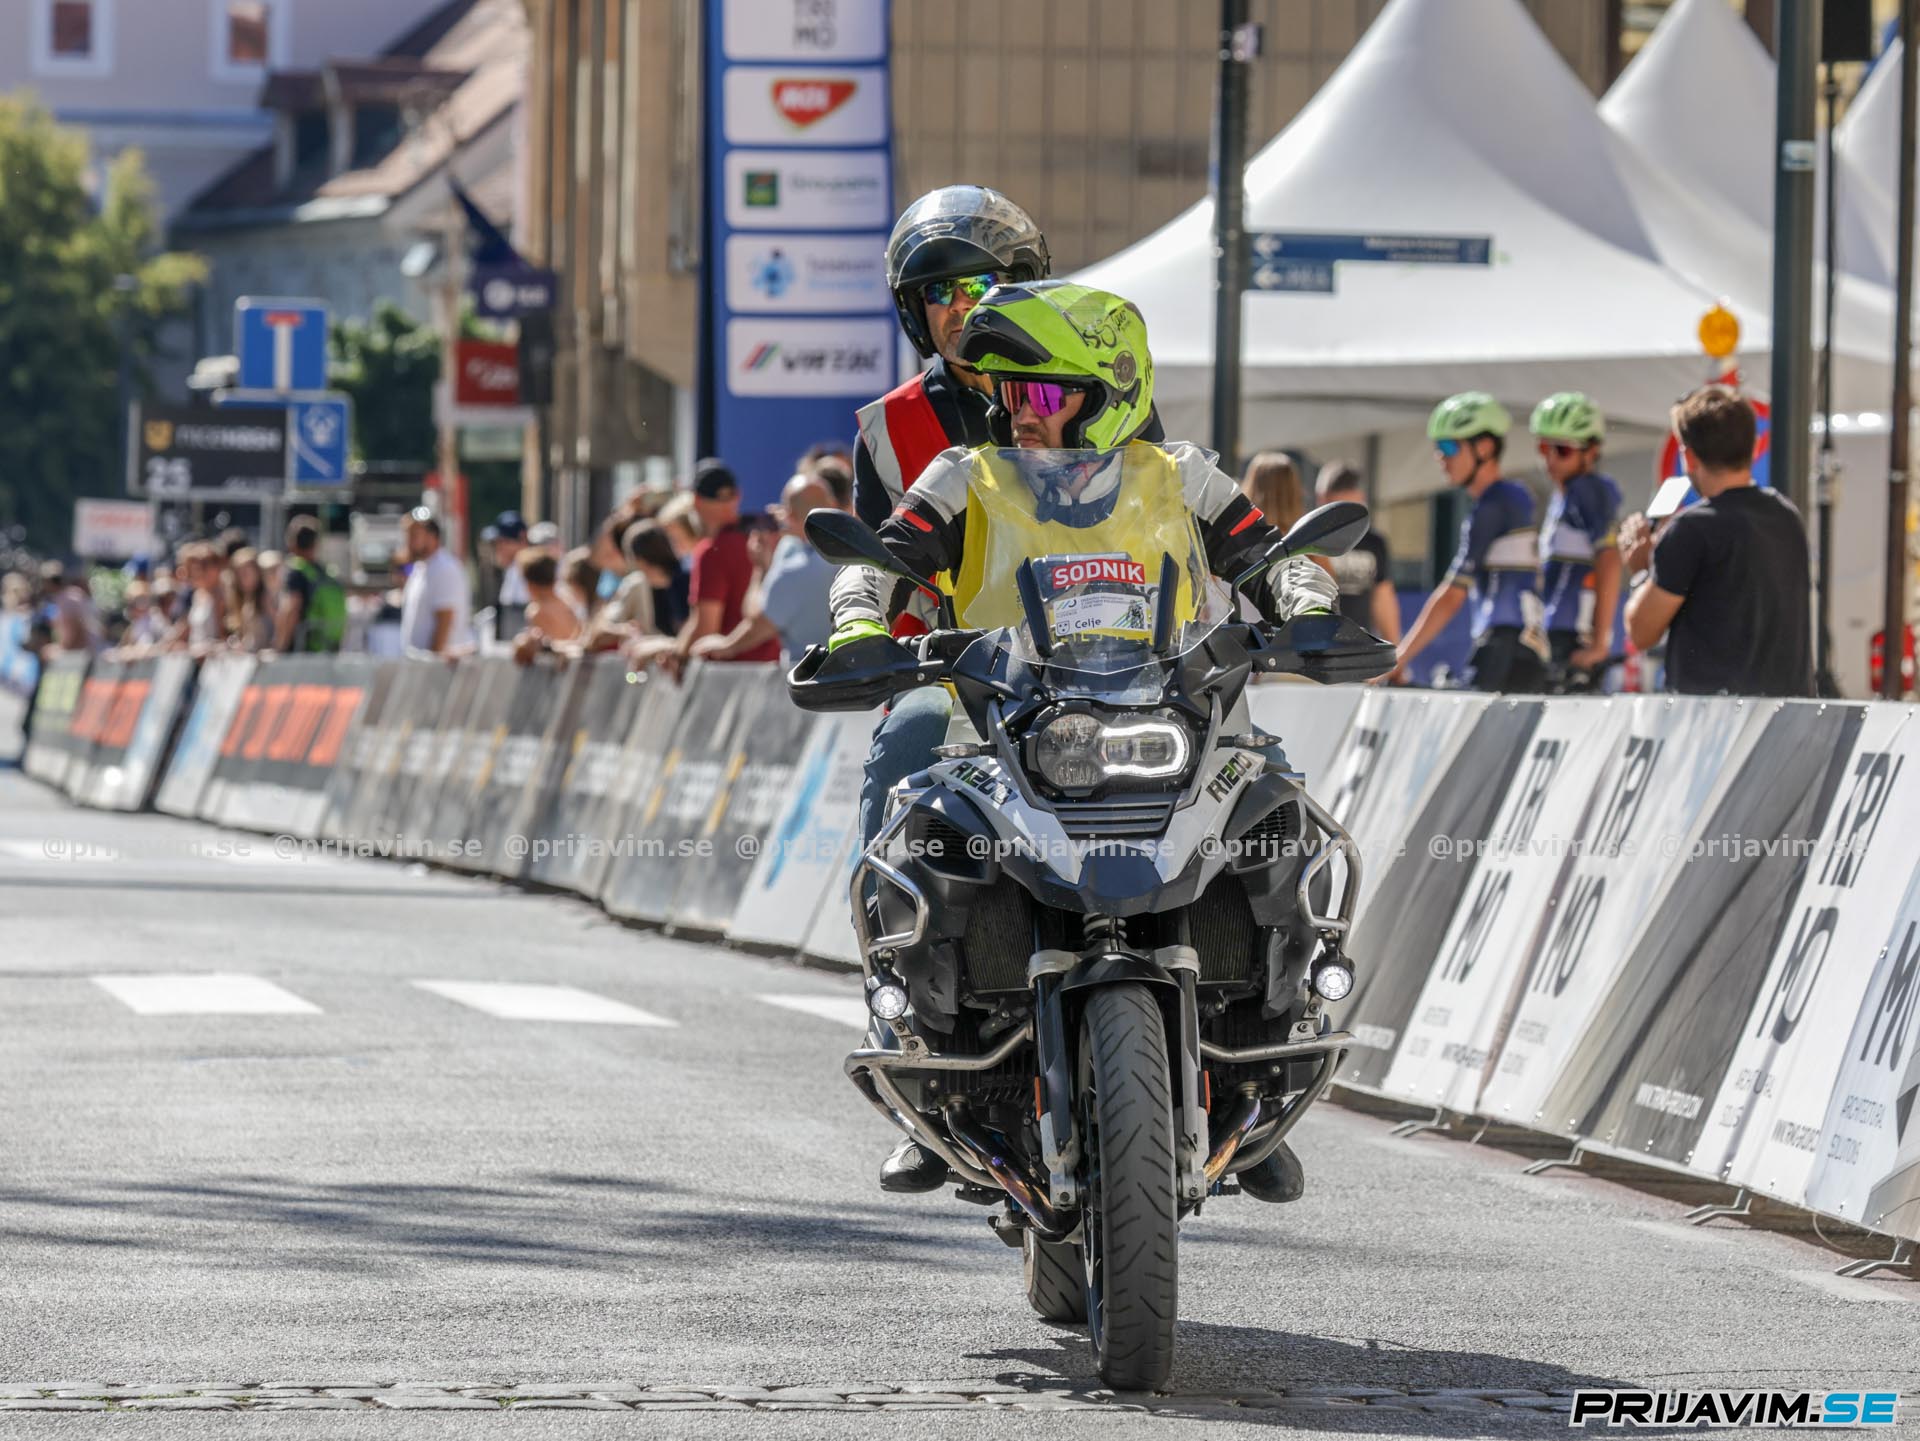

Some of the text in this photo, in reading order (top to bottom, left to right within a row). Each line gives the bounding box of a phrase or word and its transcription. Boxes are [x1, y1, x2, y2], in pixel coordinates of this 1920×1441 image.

[1055, 561, 1144, 586] SODNIK
[1074, 617, 1102, 629] Celje
[1205, 751, 1253, 804] R1200
[1817, 752, 1906, 889] TRI
[1756, 906, 1839, 1044] MO
